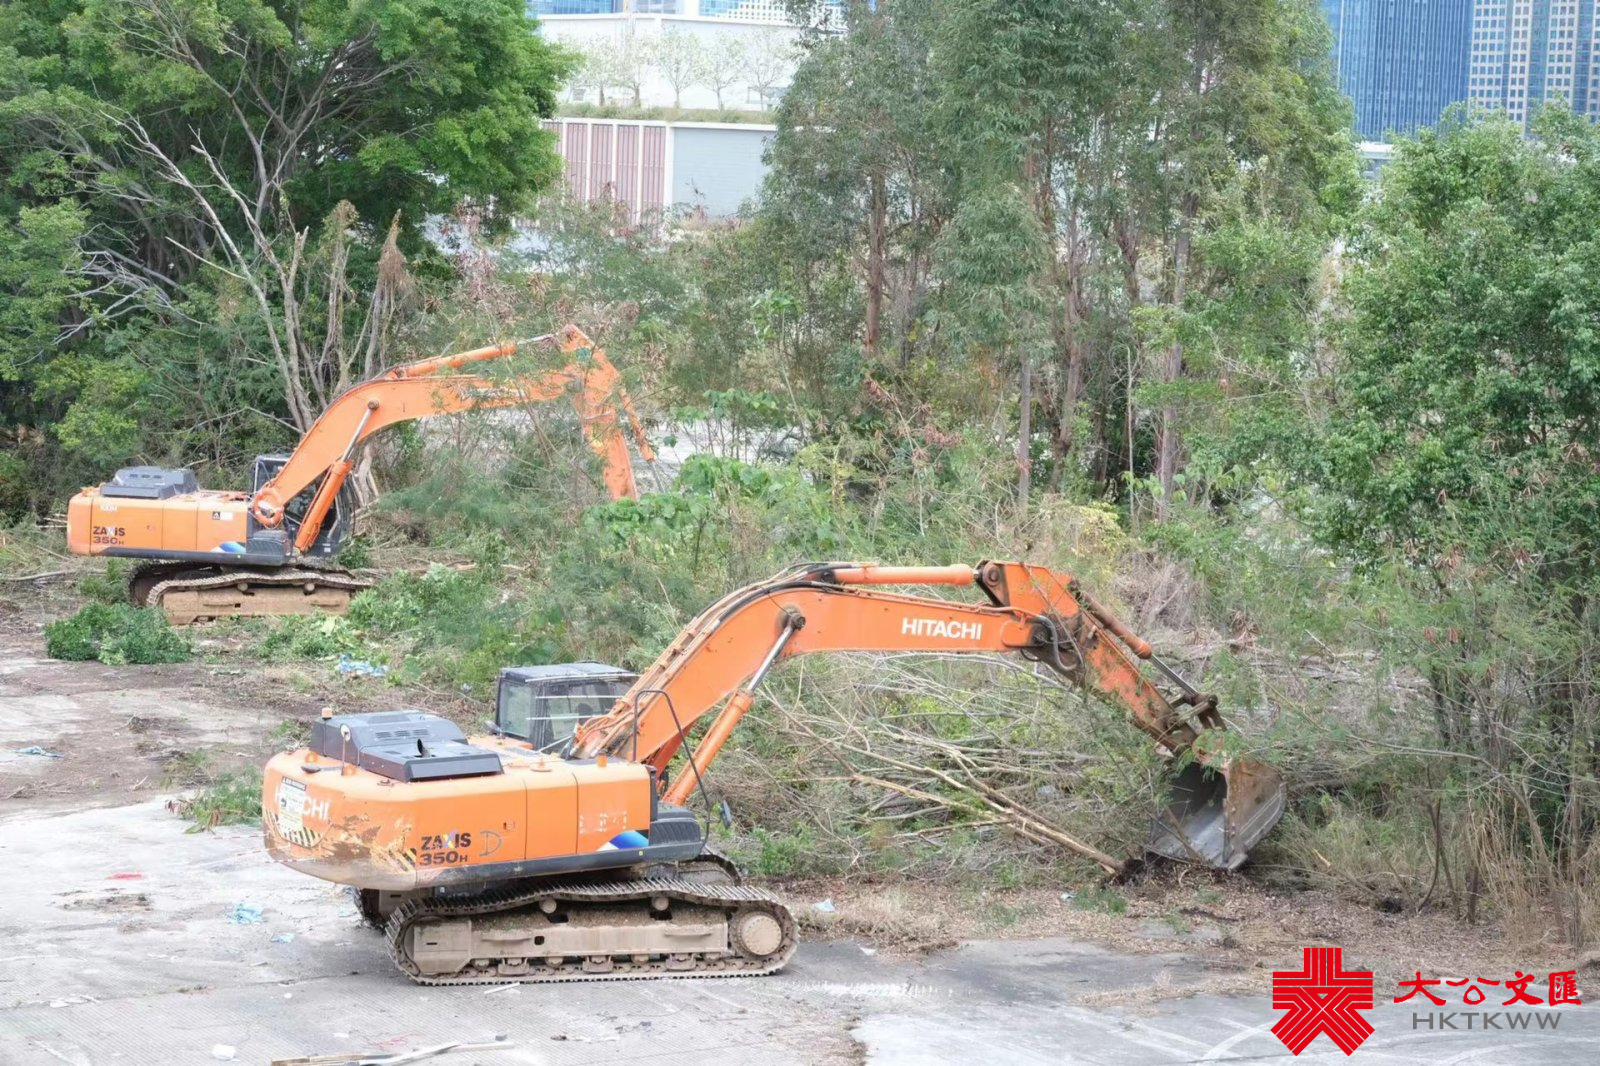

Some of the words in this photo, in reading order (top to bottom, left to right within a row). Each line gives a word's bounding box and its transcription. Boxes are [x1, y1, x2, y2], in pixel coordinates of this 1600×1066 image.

[901, 617, 983, 640] HITACHI
[420, 829, 472, 851] ZAXIS
[419, 850, 468, 866] 350H
